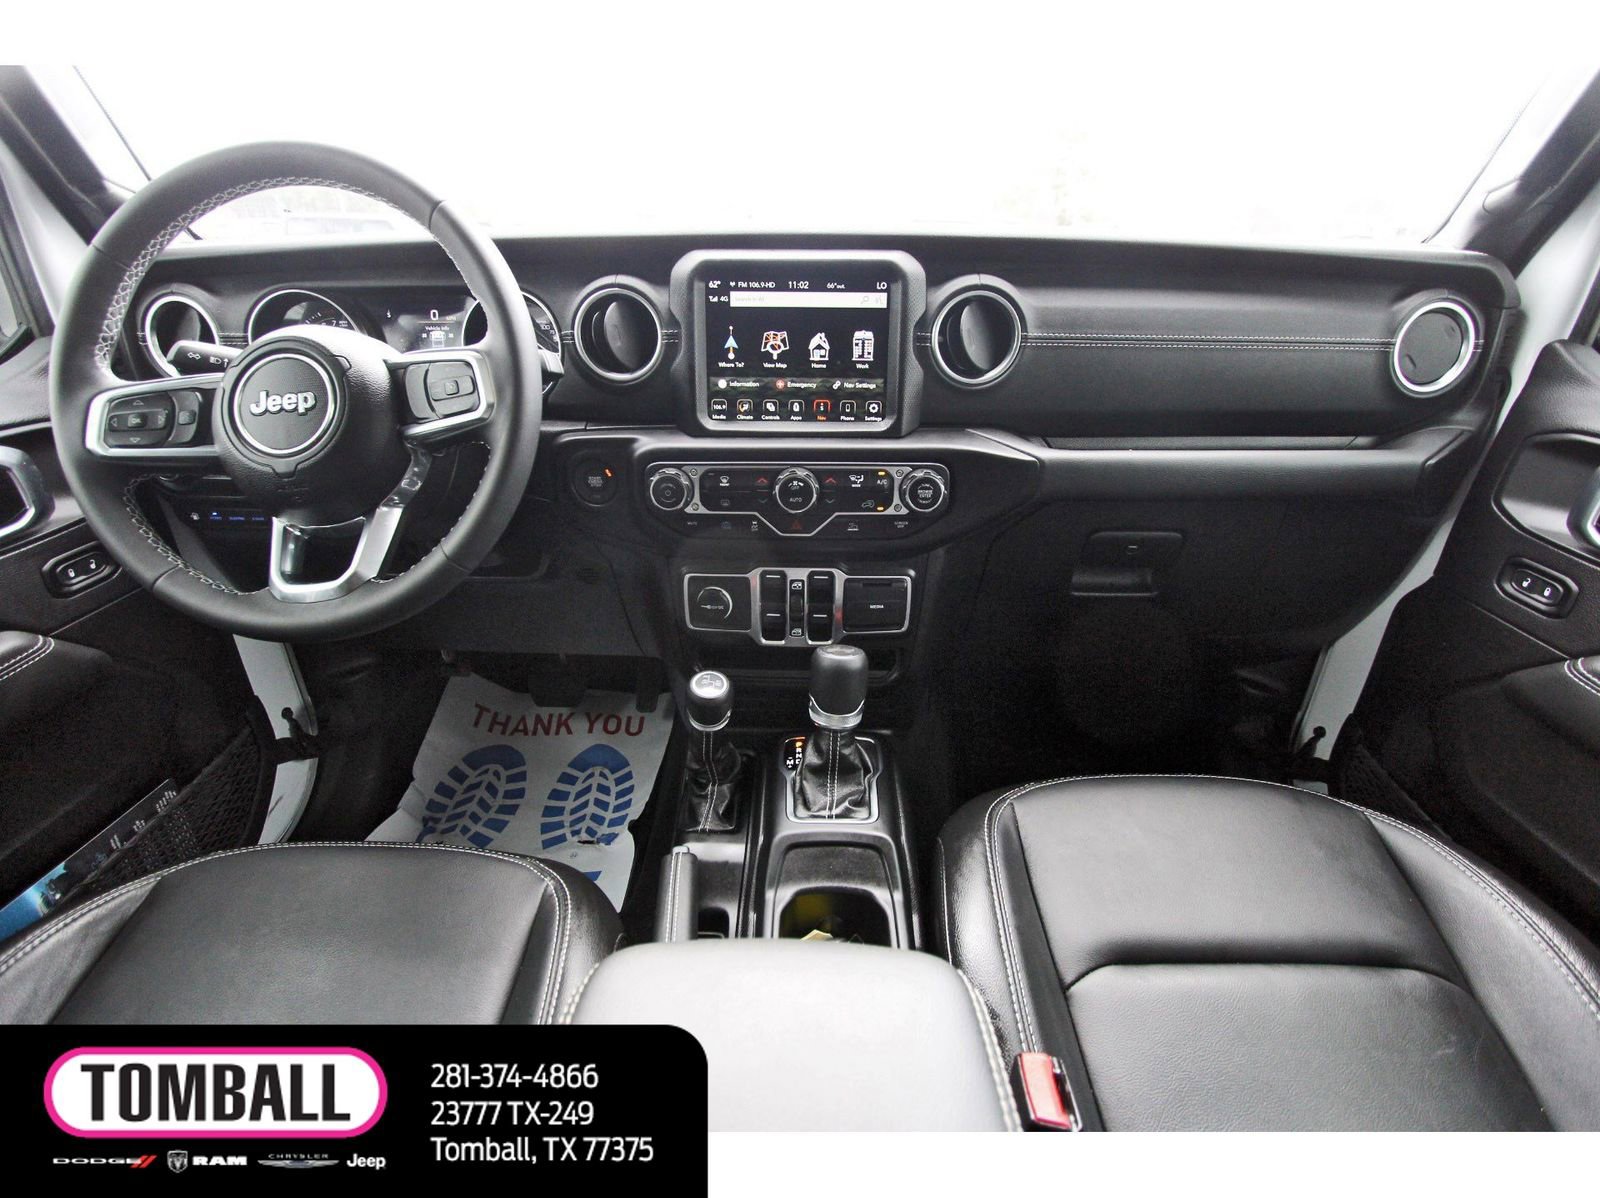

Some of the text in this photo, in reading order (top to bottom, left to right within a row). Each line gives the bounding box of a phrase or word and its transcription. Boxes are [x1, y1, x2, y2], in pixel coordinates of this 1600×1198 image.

[788, 281, 809, 290] 11:02
[876, 282, 888, 290] LO
[430, 309, 439, 321] 0
[787, 381, 817, 389] Emergency
[855, 382, 876, 390] Settings
[250, 390, 316, 416] Jeep
[473, 702, 646, 737] THANK YOU
